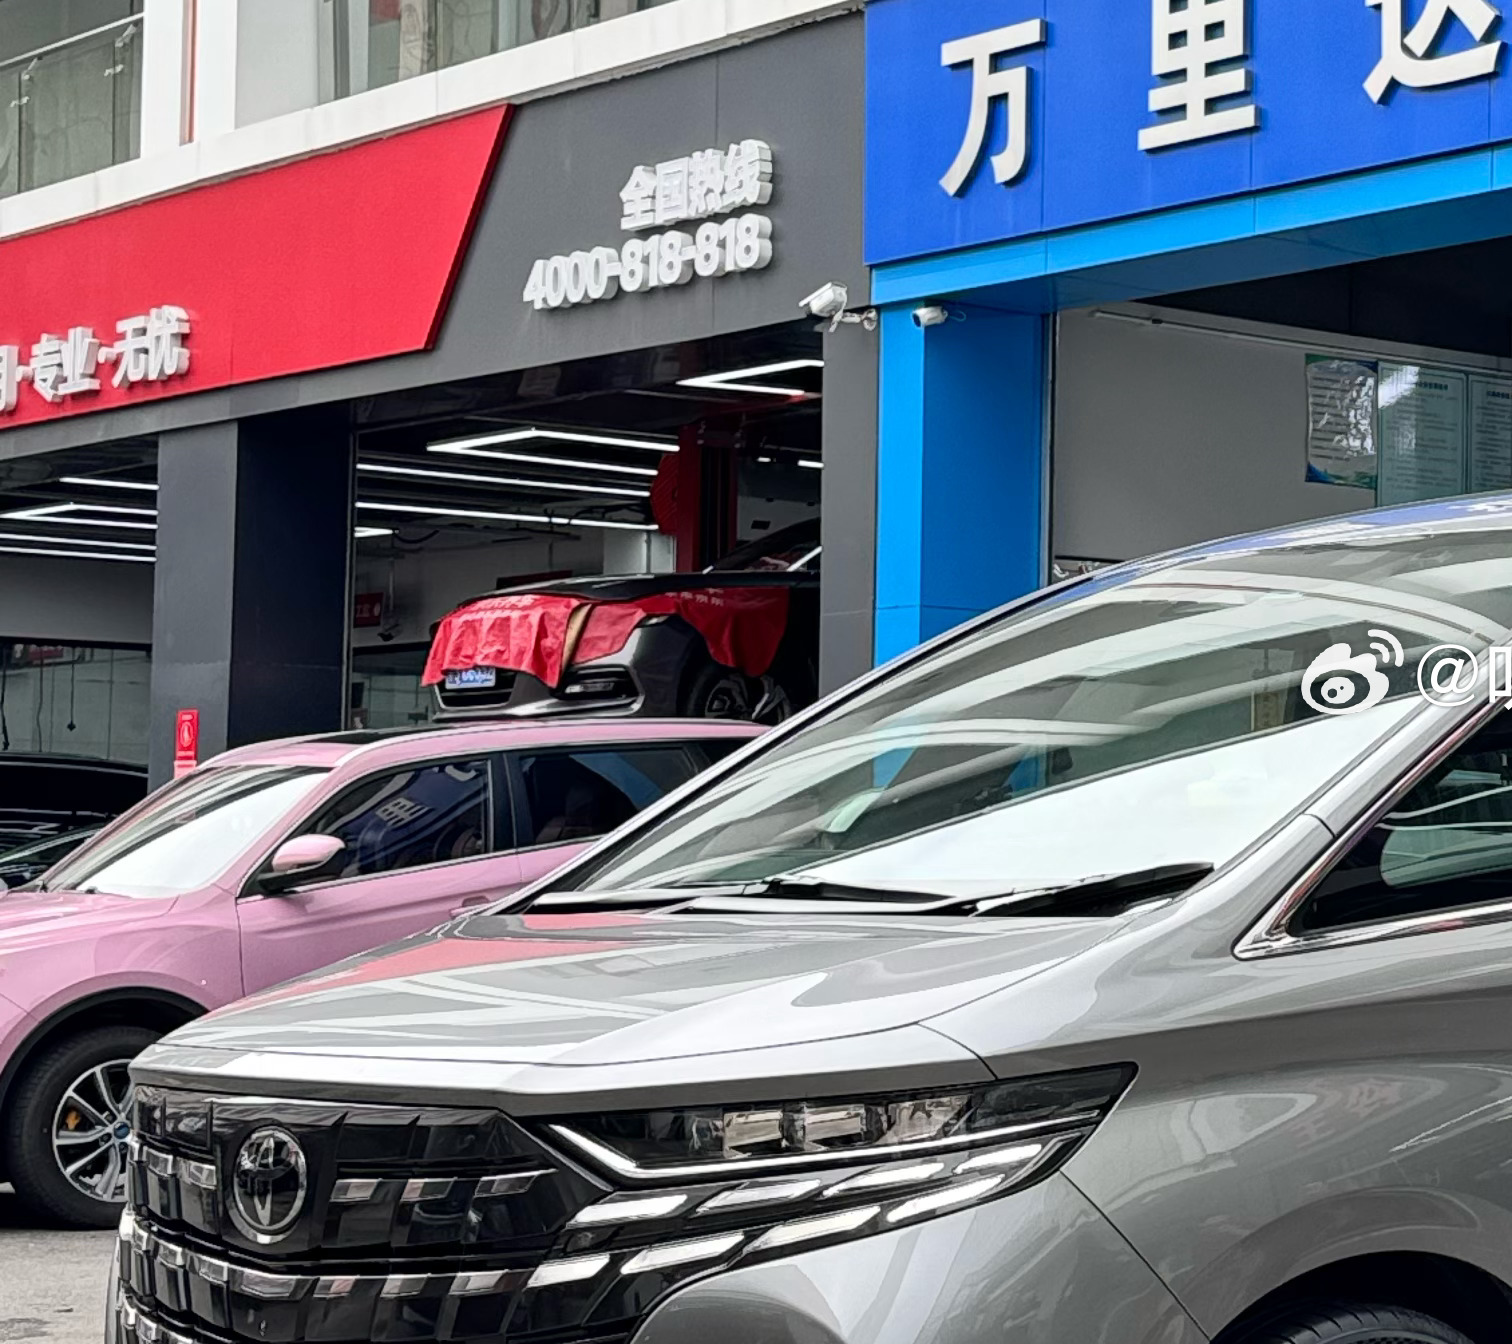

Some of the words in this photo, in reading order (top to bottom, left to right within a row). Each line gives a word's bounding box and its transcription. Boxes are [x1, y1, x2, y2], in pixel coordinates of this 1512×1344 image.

[618, 139, 773, 232] 全国热线
[522, 213, 773, 311] 4000-818-818
